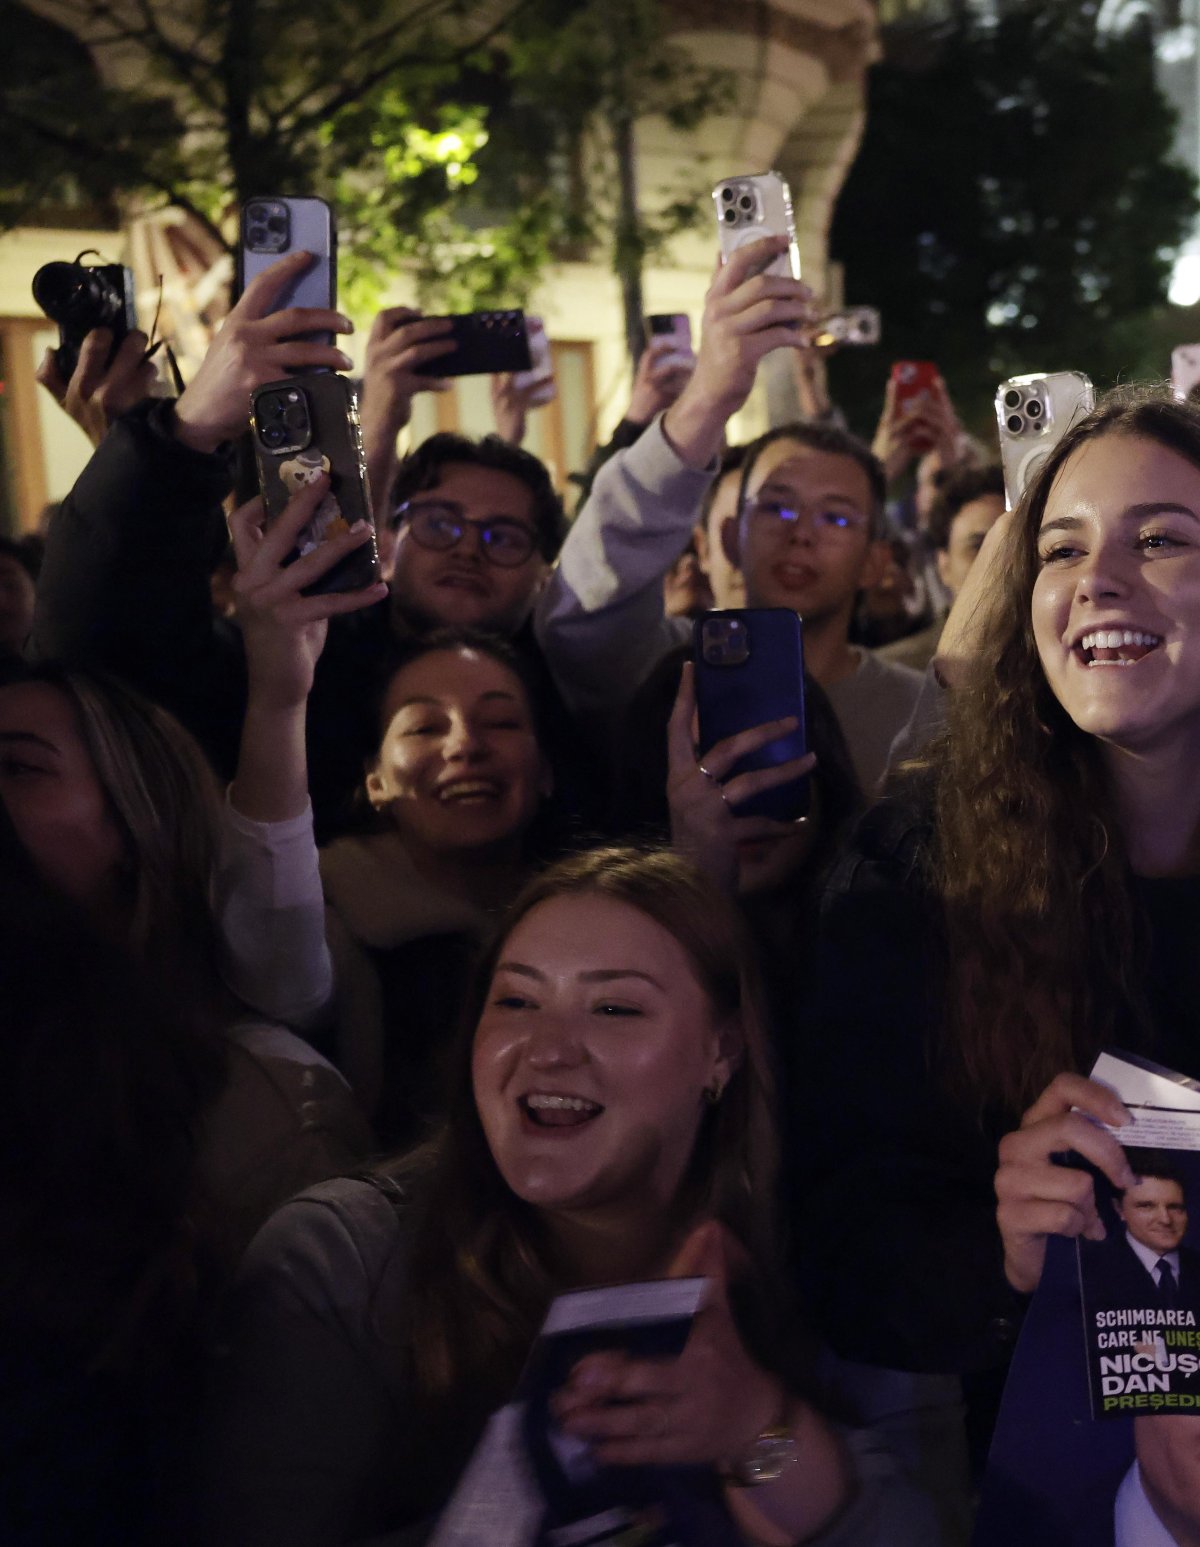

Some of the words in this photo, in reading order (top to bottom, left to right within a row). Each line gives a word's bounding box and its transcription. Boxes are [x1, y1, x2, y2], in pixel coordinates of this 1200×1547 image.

[1096, 1309, 1196, 1328] SCHIMBAREA
[1097, 1330, 1139, 1349] CARE
[1101, 1373, 1171, 1396] DAN
